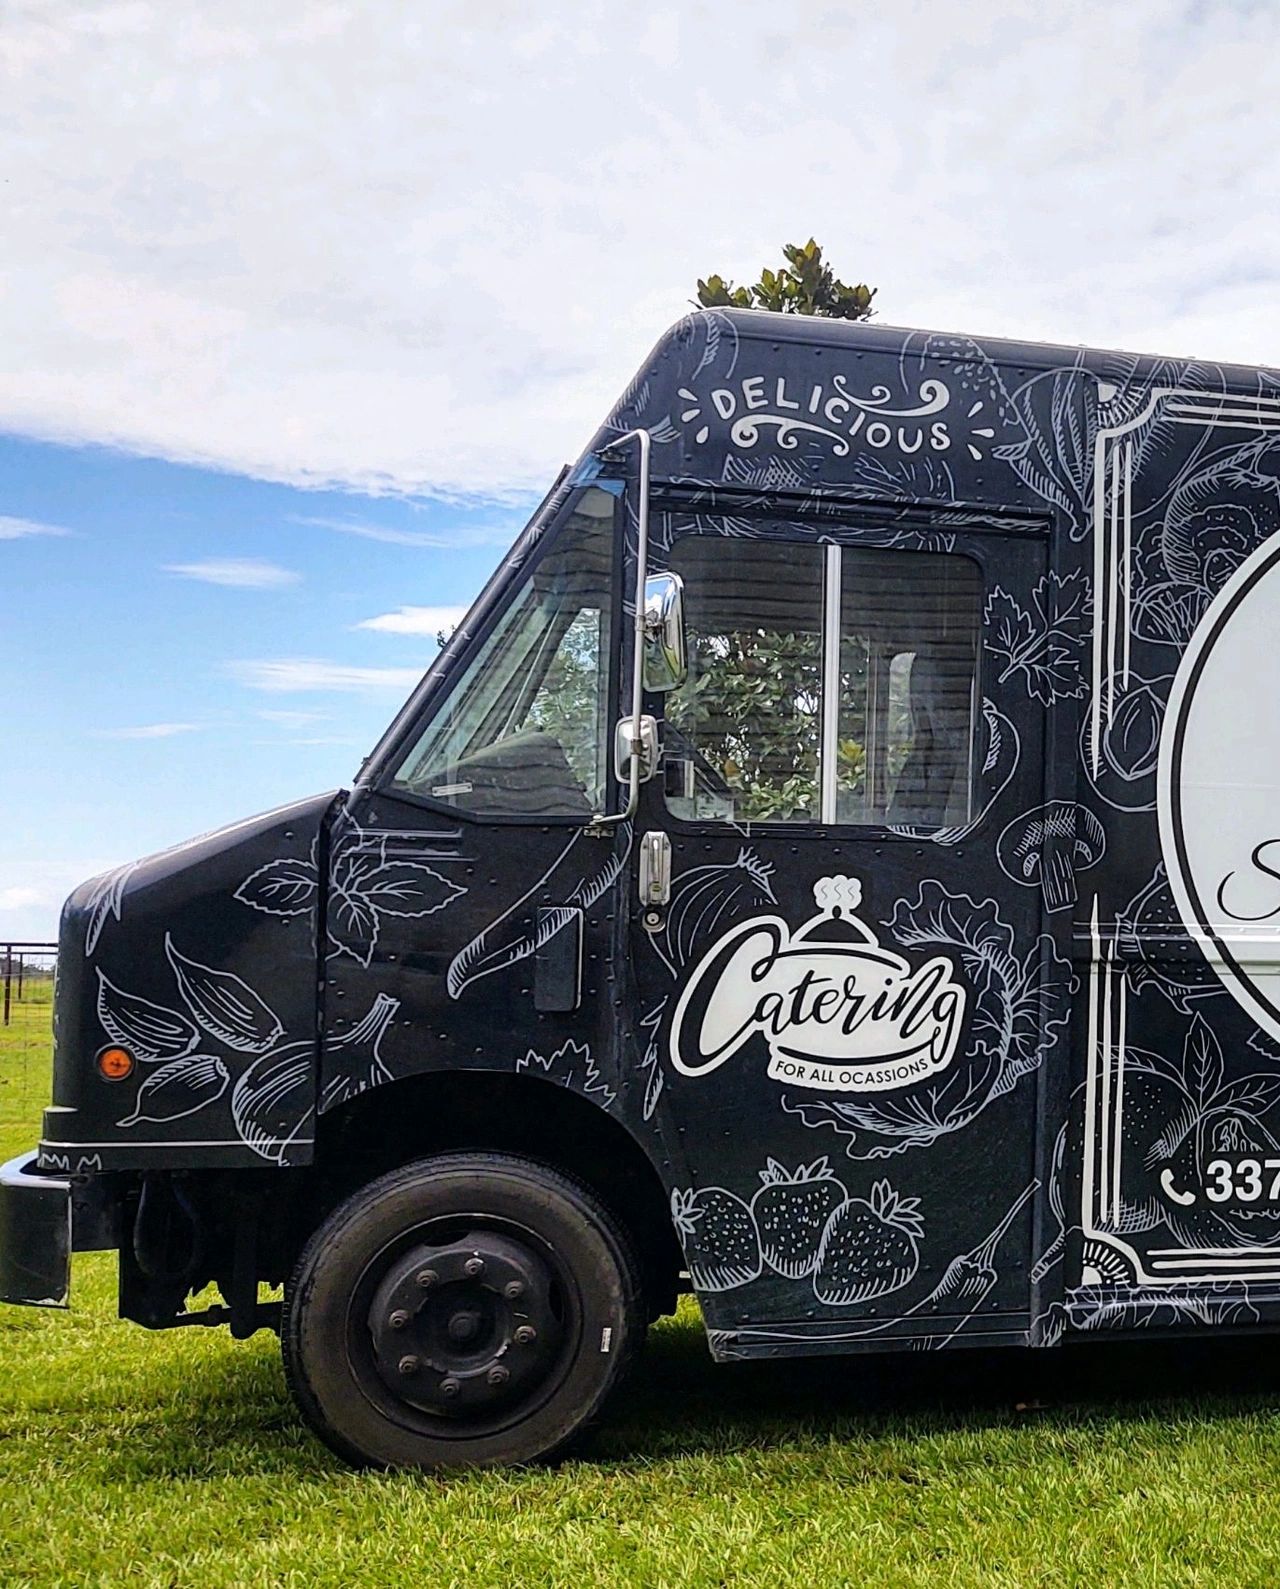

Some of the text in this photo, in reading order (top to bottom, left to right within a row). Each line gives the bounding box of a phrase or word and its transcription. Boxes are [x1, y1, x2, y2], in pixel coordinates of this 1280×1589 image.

[711, 376, 951, 452] DELICIOUS
[677, 921, 958, 1070] Catering
[775, 1058, 929, 1085] FOR ALL OCASSIONS
